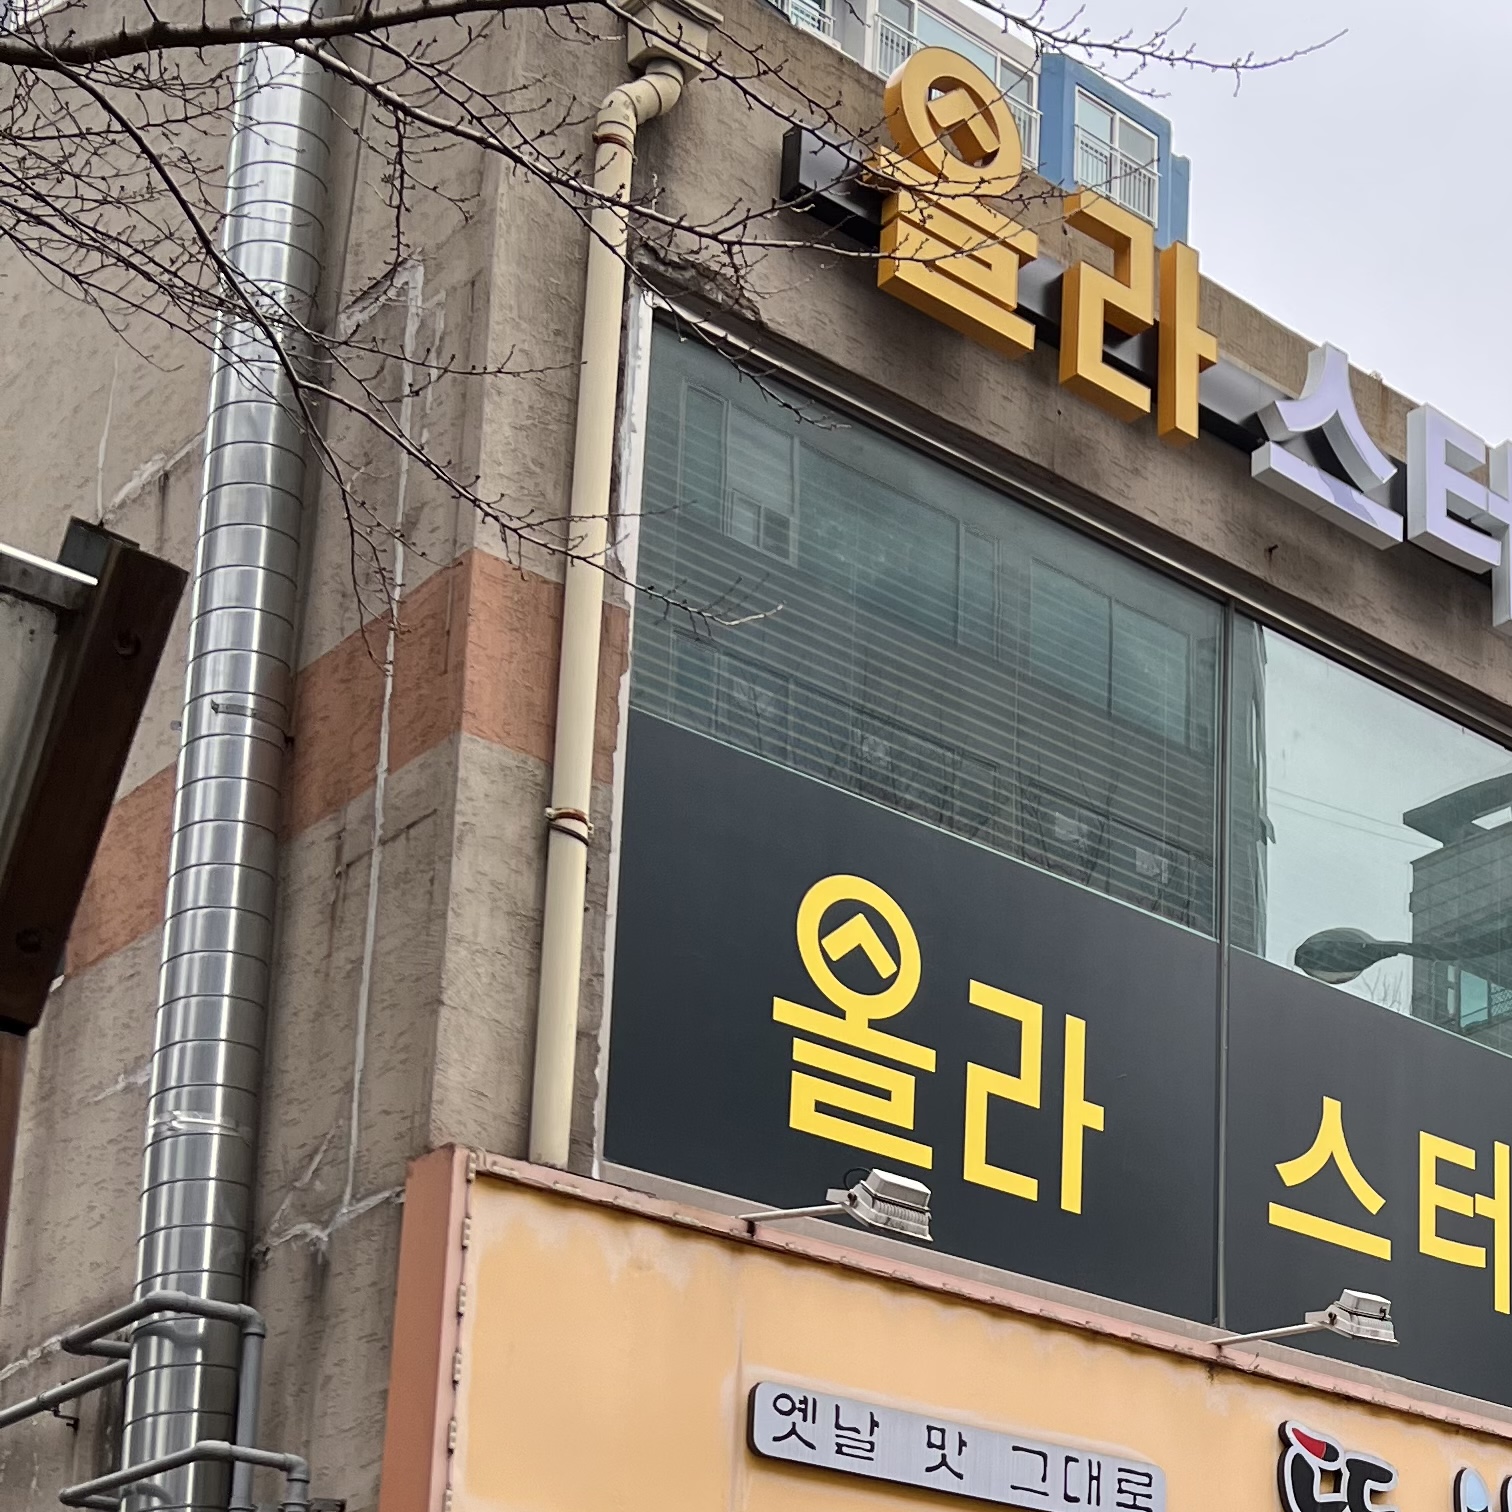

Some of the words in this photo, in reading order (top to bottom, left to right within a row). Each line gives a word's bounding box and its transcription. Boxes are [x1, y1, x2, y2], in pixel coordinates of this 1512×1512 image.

[863, 46, 1217, 447] 올라
[772, 874, 1105, 1215] 올라
[772, 1391, 880, 1462] 옛날
[924, 1423, 968, 1481] 맛
